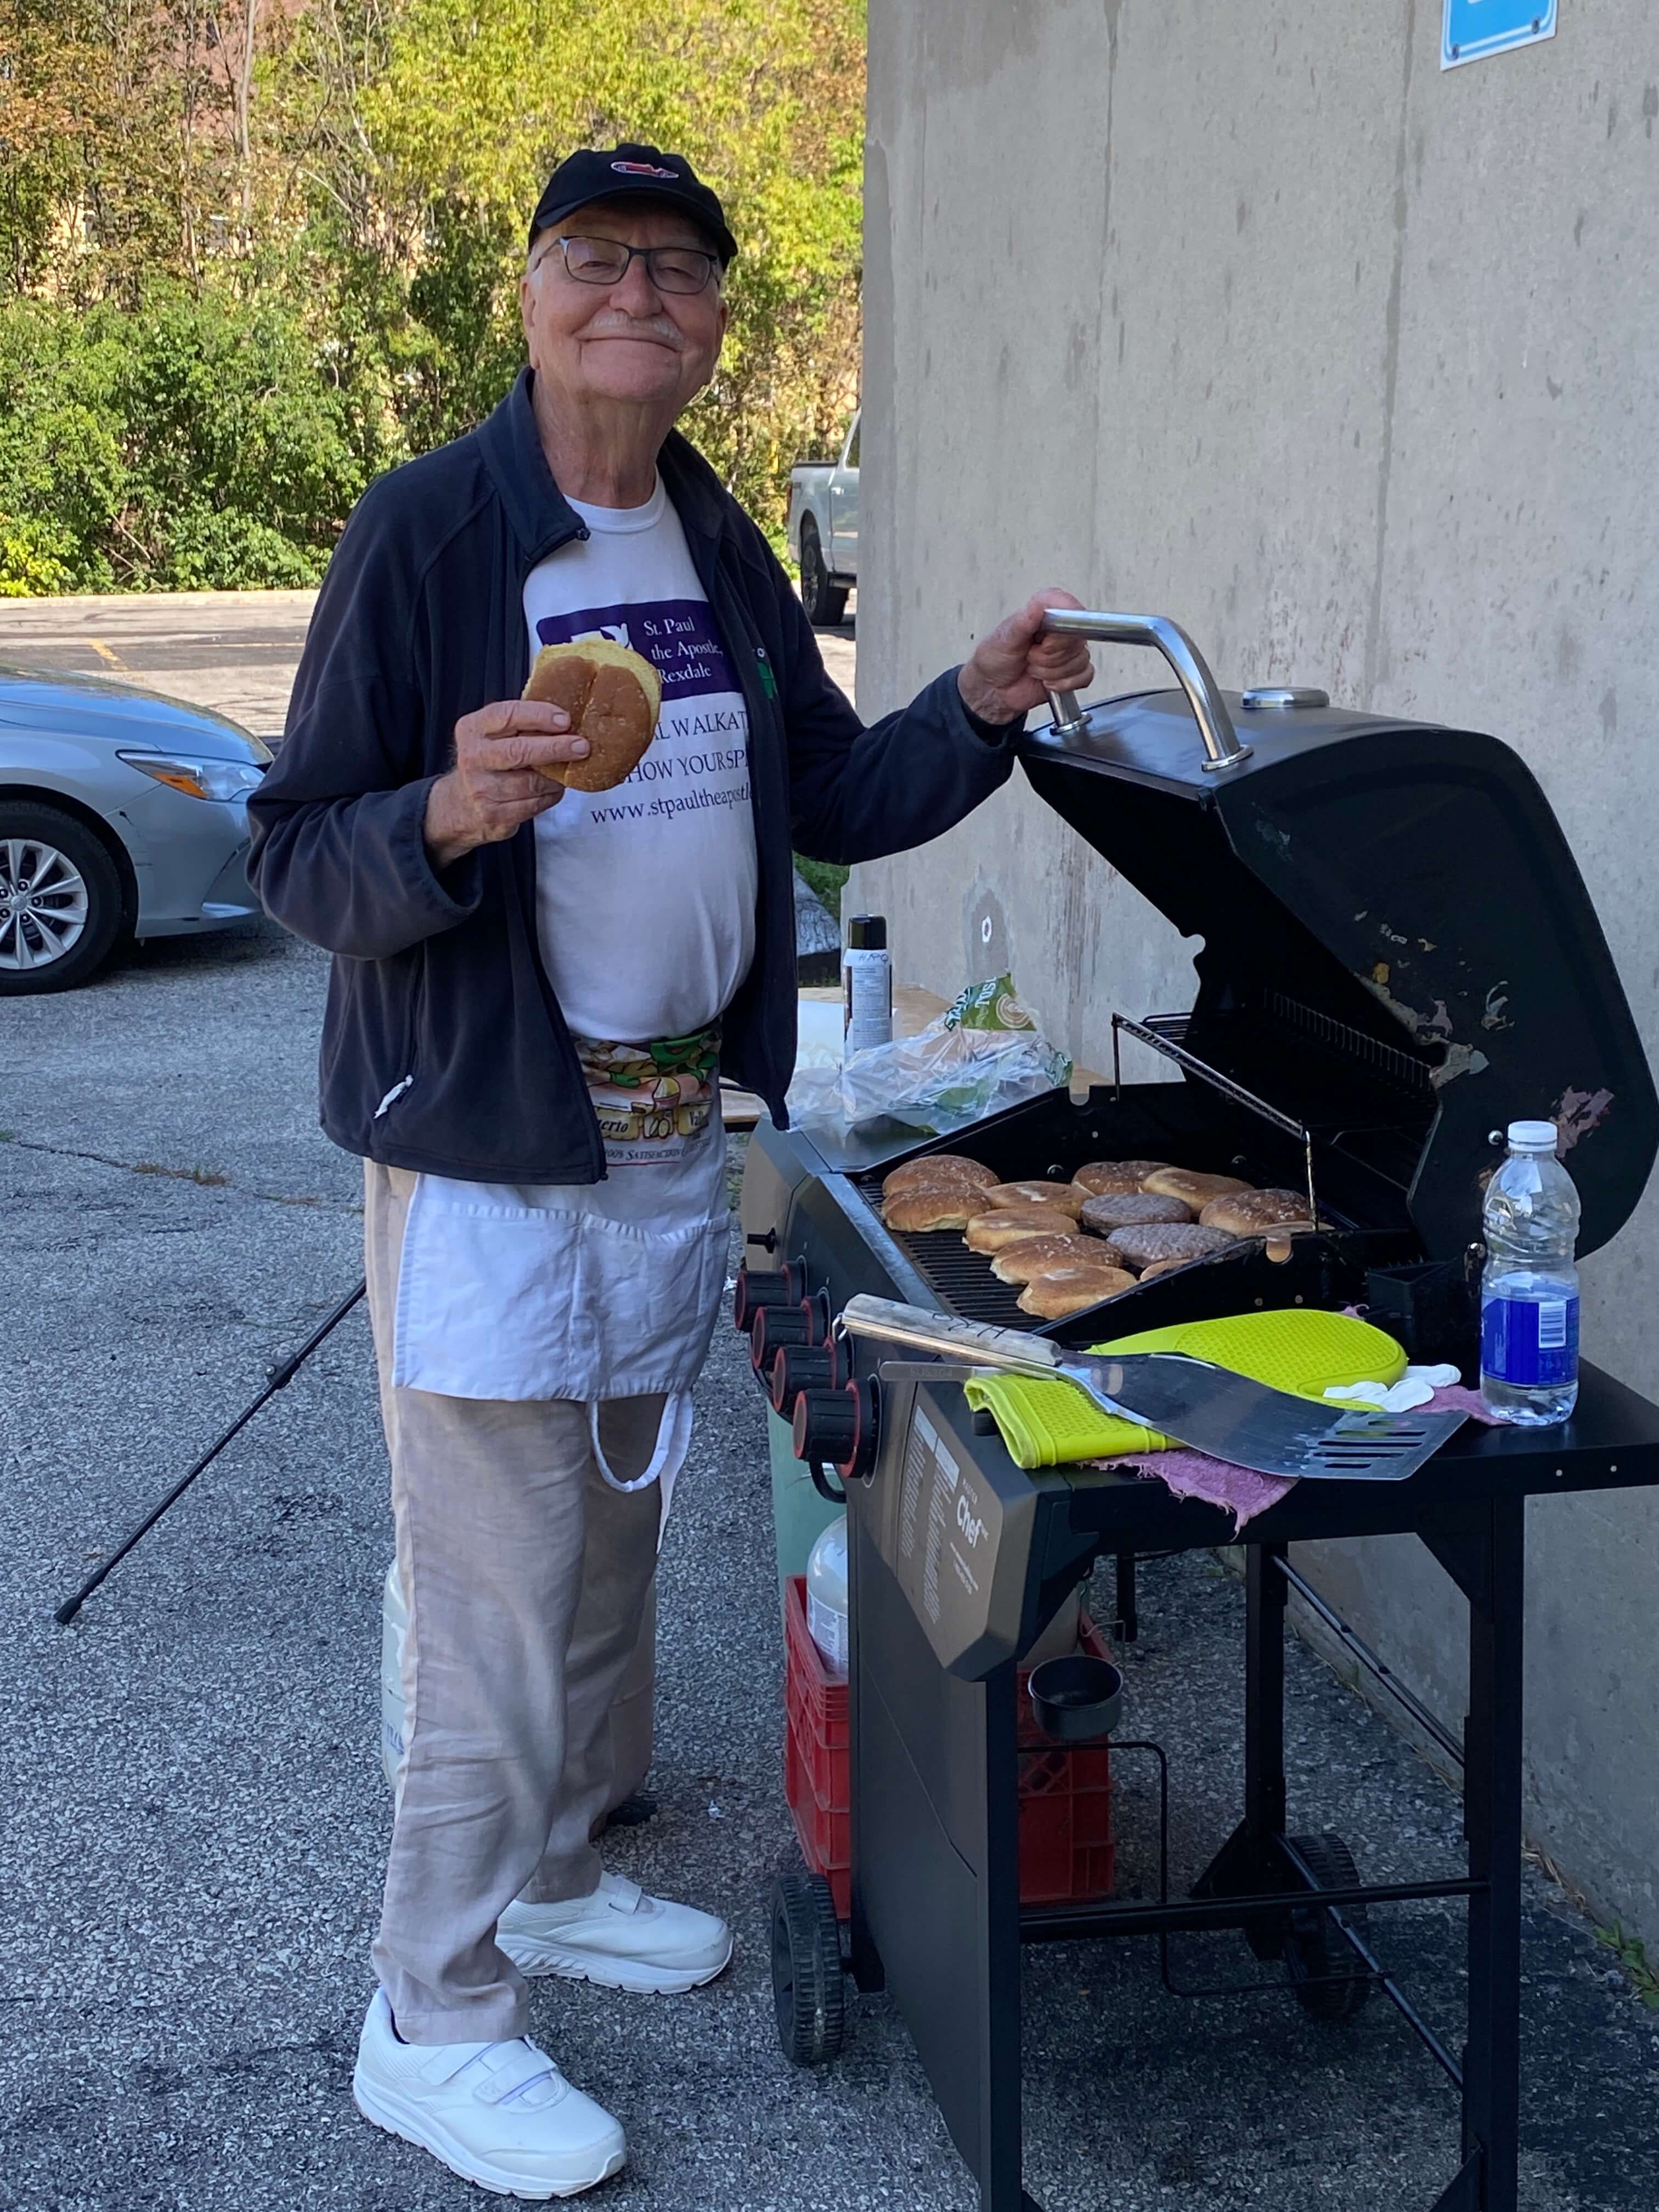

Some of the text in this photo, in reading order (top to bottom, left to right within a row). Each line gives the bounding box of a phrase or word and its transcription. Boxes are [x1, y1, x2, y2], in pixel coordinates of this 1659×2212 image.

[643, 616, 695, 636] St. Paul
[651, 639, 723, 660] the Apostle,
[658, 662, 712, 684] Rexdale
[676, 752, 725, 776] YOUR
[725, 749, 748, 770] SP
[957, 1494, 982, 1549] Chef
